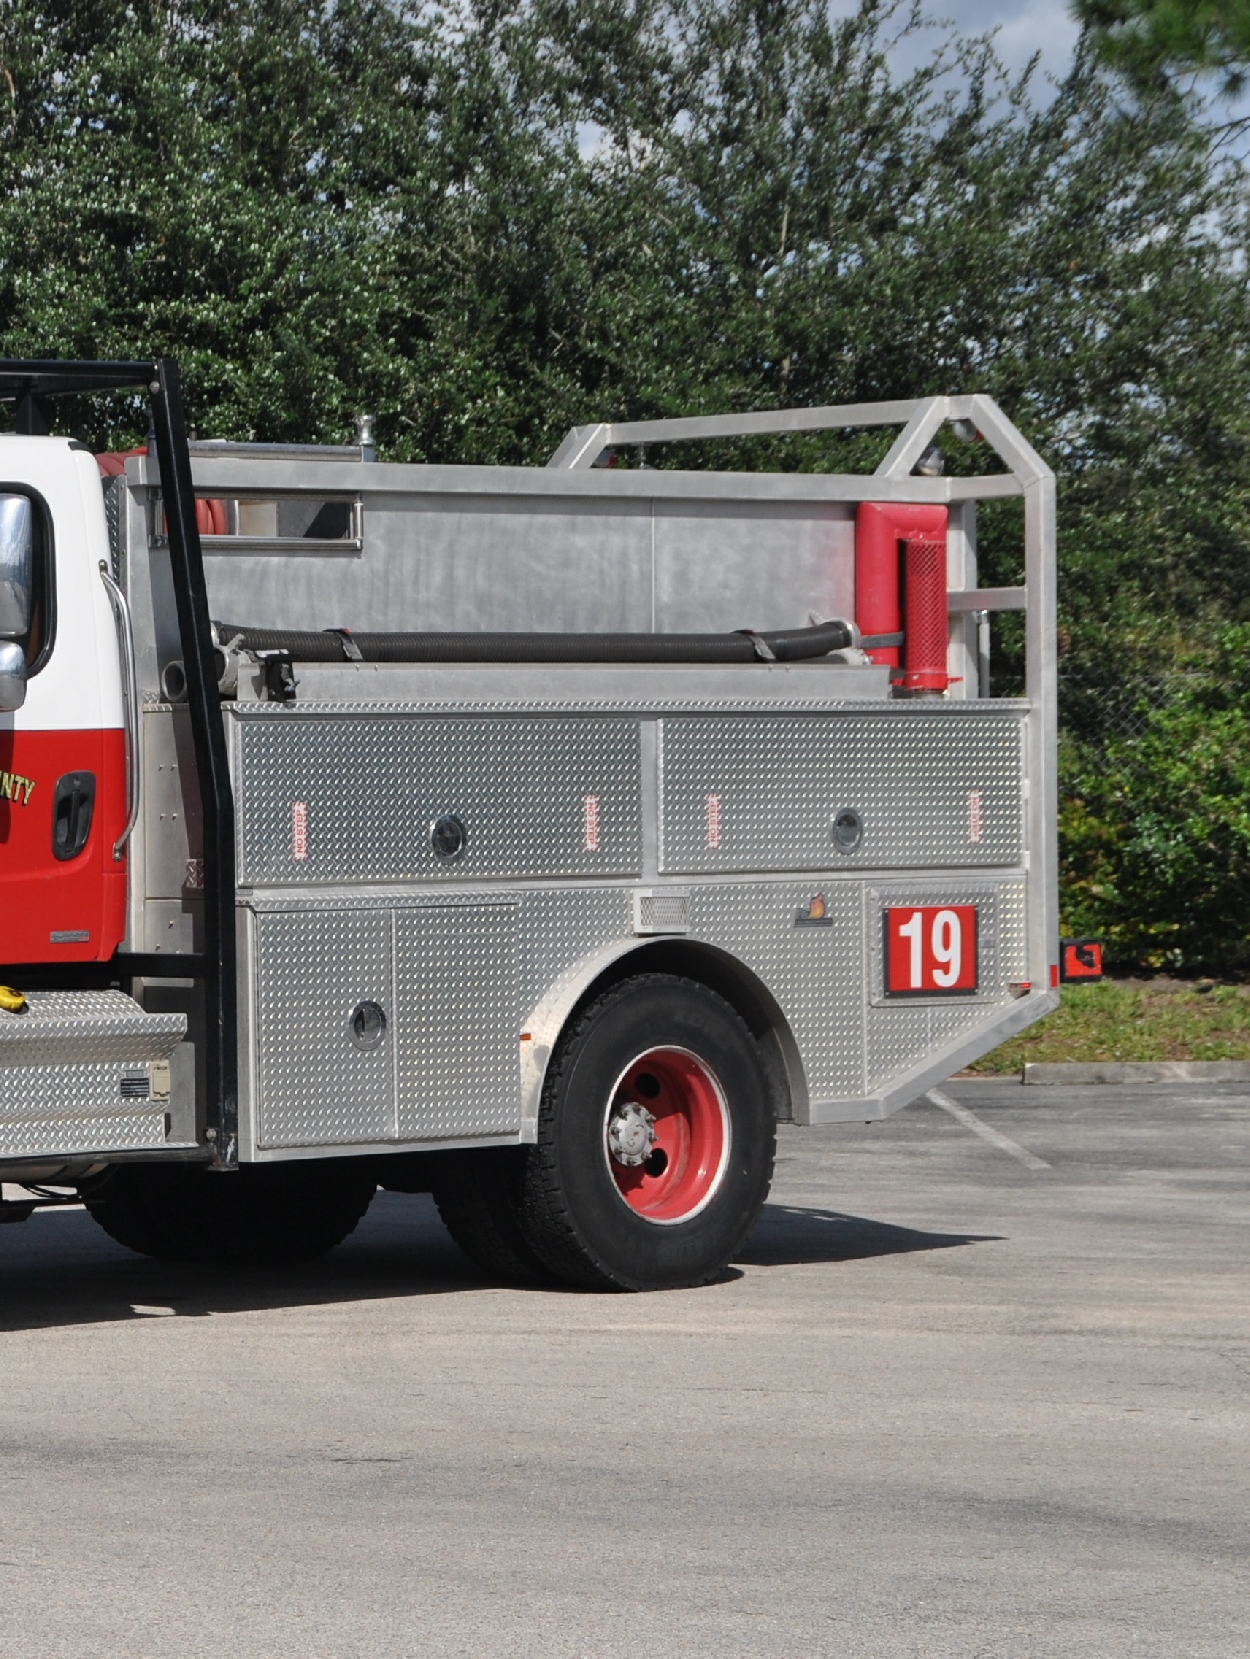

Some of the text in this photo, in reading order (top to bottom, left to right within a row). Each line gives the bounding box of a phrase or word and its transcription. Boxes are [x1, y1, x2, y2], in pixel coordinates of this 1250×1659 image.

[296, 810, 304, 853] NO STEP
[899, 909, 962, 989] 19
